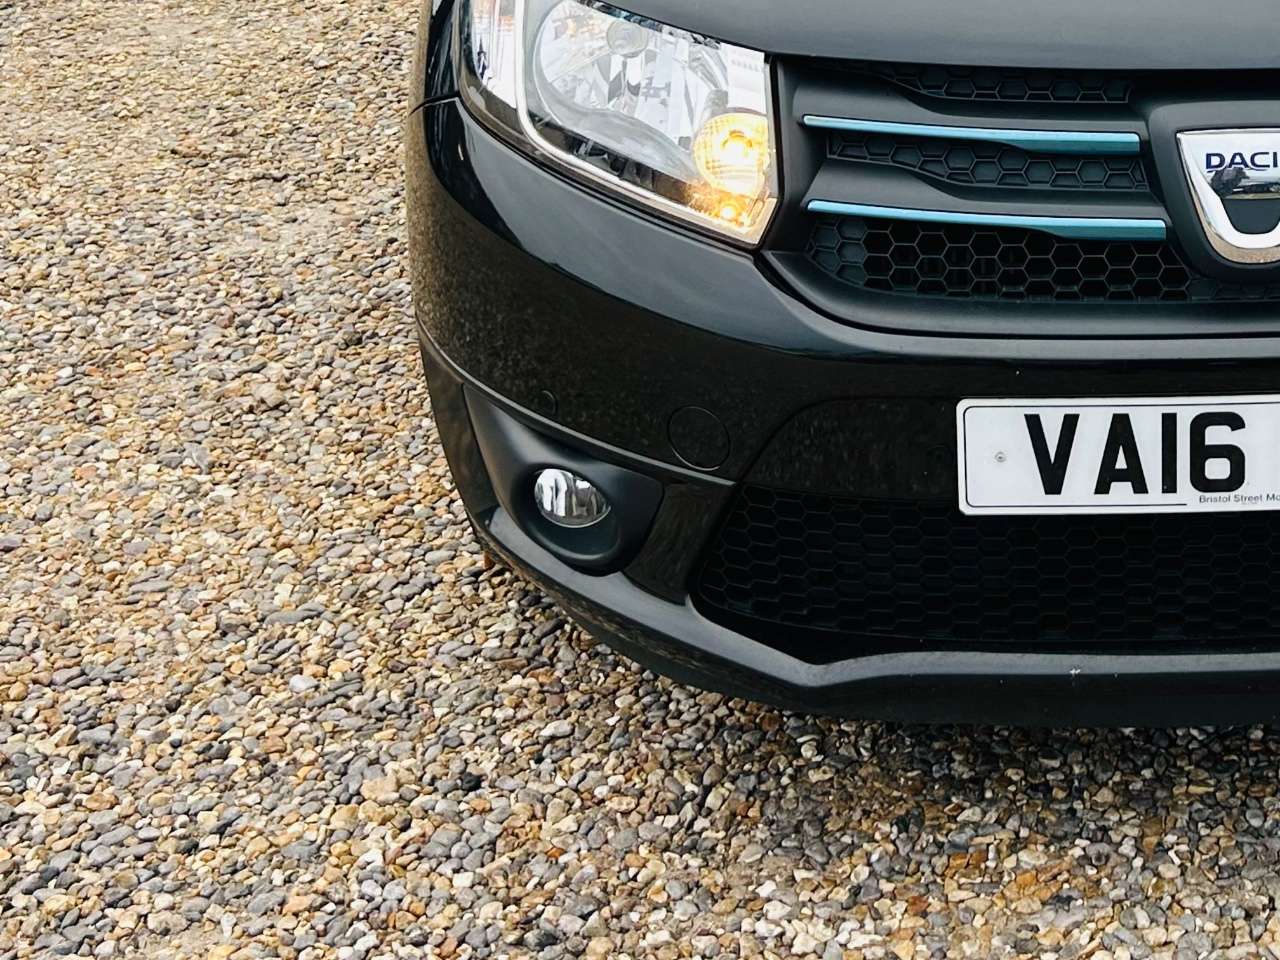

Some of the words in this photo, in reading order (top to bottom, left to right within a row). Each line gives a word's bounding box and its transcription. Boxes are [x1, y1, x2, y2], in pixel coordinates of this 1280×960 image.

[1023, 411, 1246, 495] VA16
[1199, 494, 1231, 503] Bristol
[1233, 493, 1263, 503] Street
